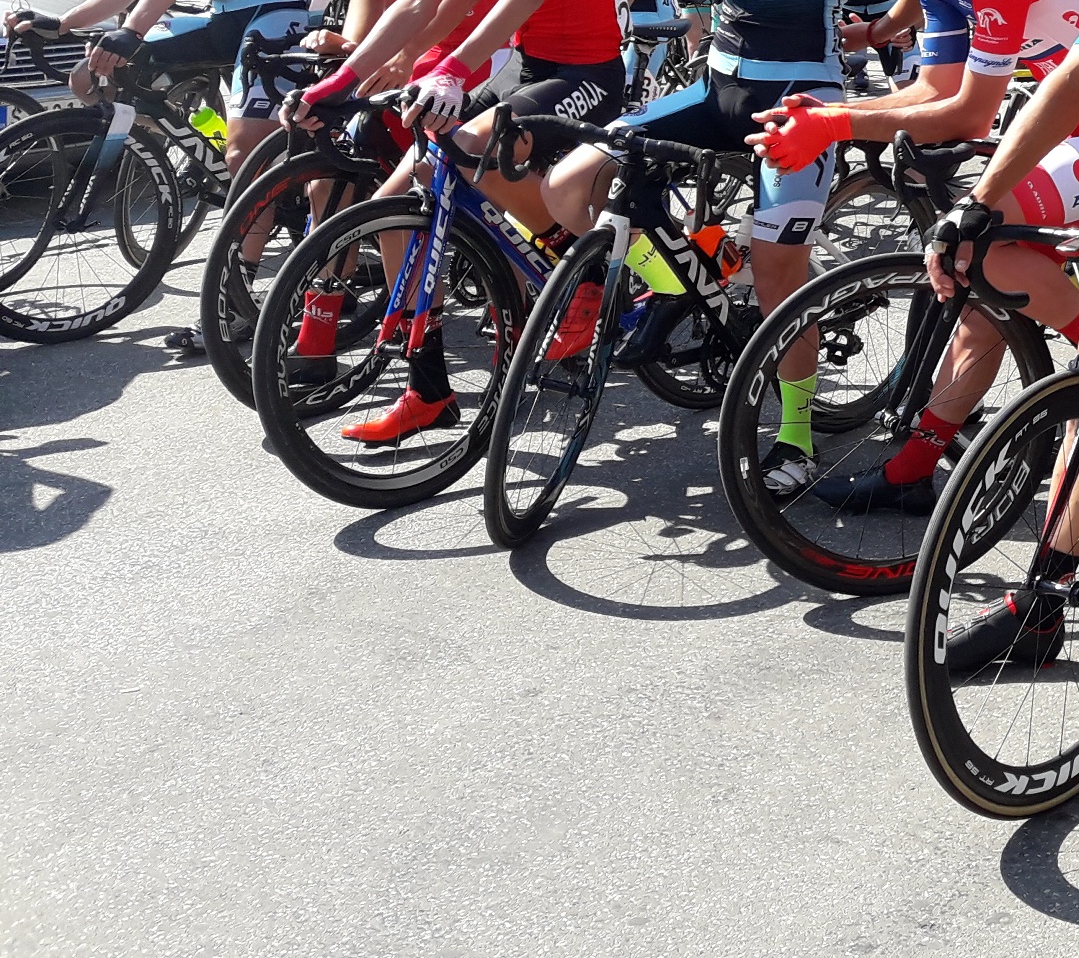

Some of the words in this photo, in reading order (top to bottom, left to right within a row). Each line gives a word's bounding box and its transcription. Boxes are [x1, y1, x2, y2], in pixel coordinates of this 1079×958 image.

[424, 174, 456, 294] QUICK
[480, 199, 553, 274] QUIC
[25, 296, 126, 332] QUICK
[933, 442, 1012, 665] QUICK
